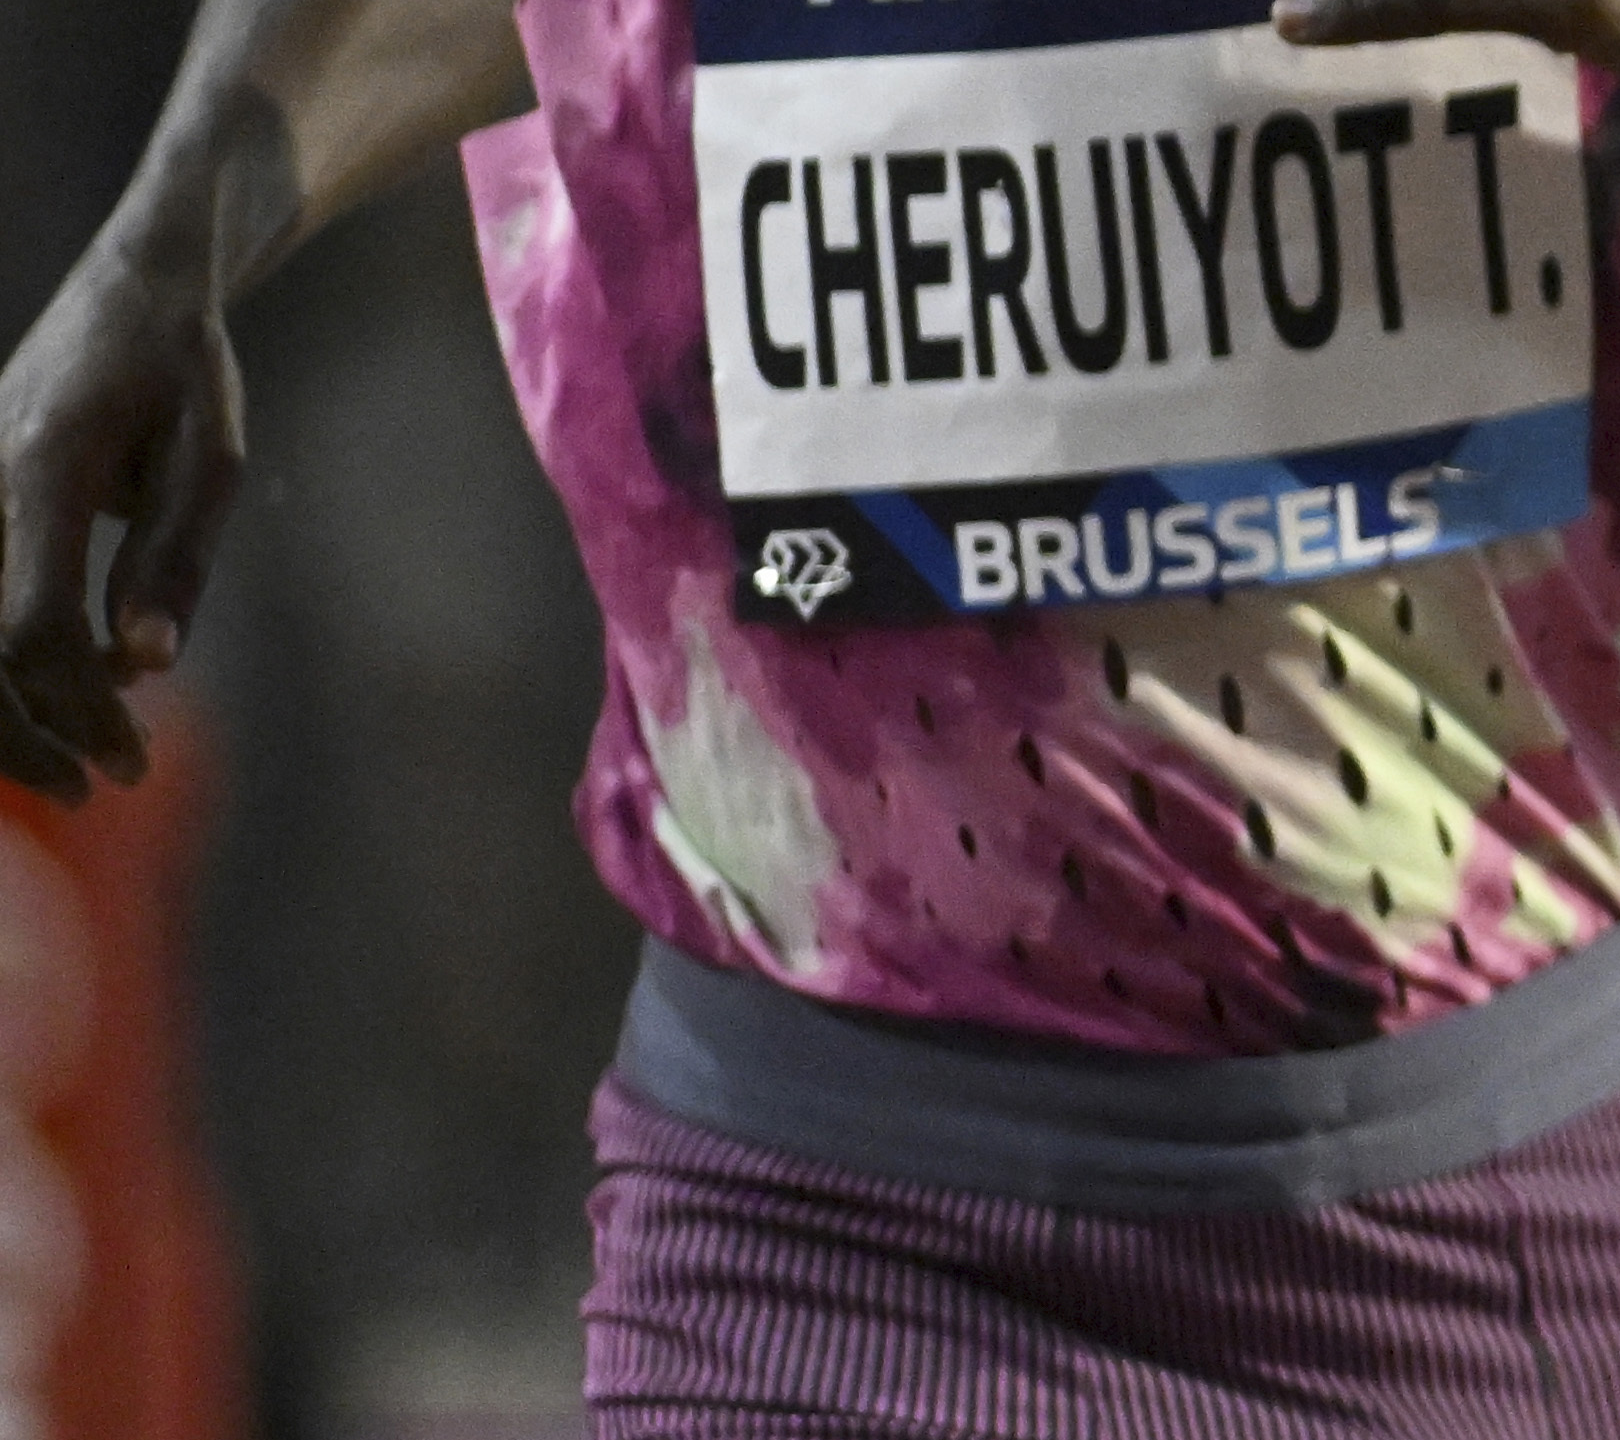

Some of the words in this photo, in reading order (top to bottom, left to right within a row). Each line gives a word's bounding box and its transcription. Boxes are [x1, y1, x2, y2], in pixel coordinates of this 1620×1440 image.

[739, 102, 1412, 390] CHERUIYOT
[1445, 84, 1562, 316] T.
[954, 469, 1440, 608] BRUSSELS
